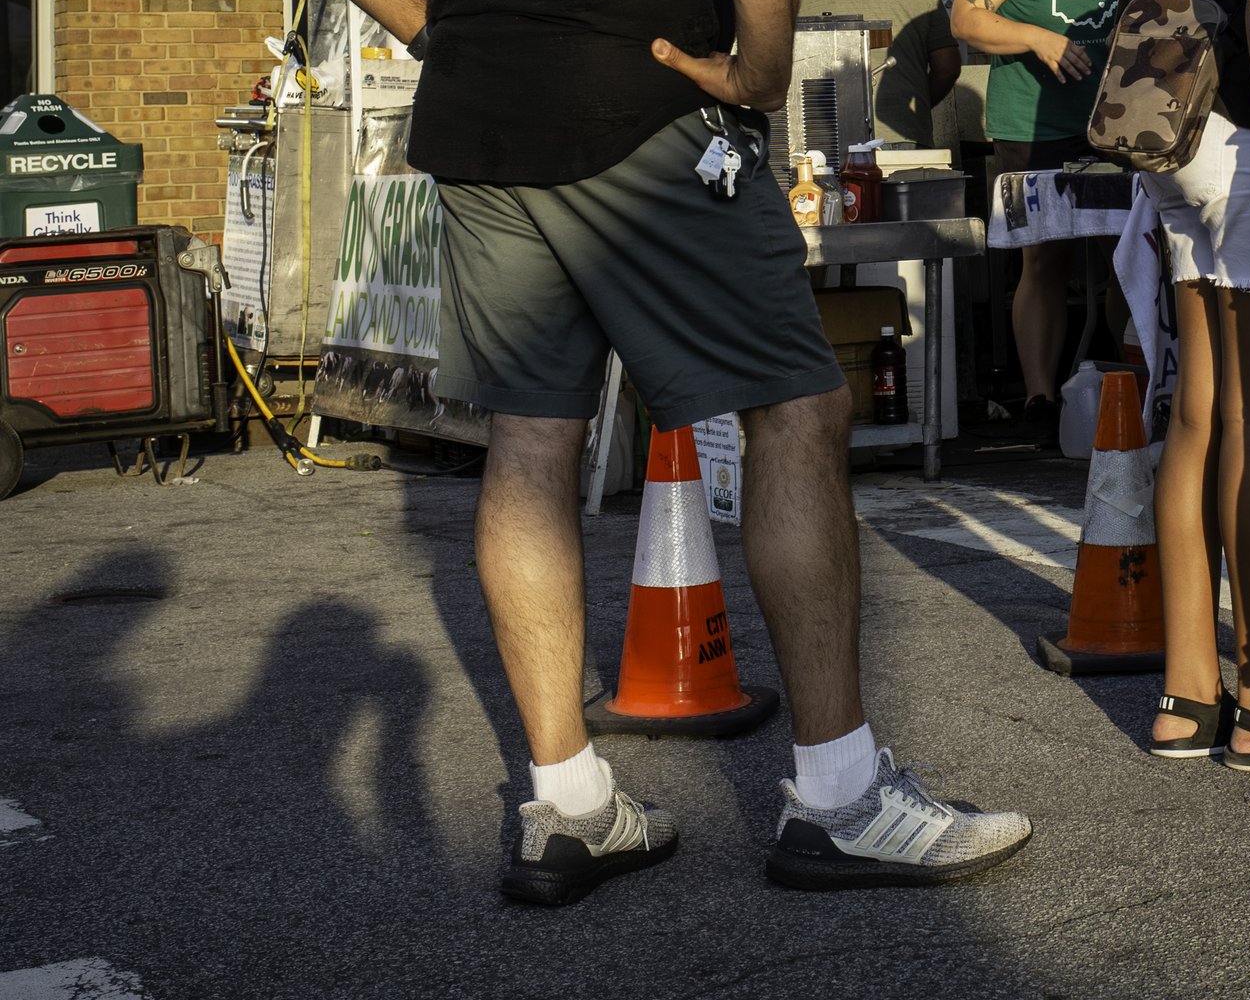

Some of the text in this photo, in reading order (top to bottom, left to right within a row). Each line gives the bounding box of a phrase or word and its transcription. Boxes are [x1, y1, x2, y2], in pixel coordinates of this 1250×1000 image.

[10, 152, 117, 173] RECYCLE
[45, 210, 80, 224] Think
[333, 180, 366, 282] 00
[362, 293, 401, 345] AND
[713, 487, 733, 499] CCOF
